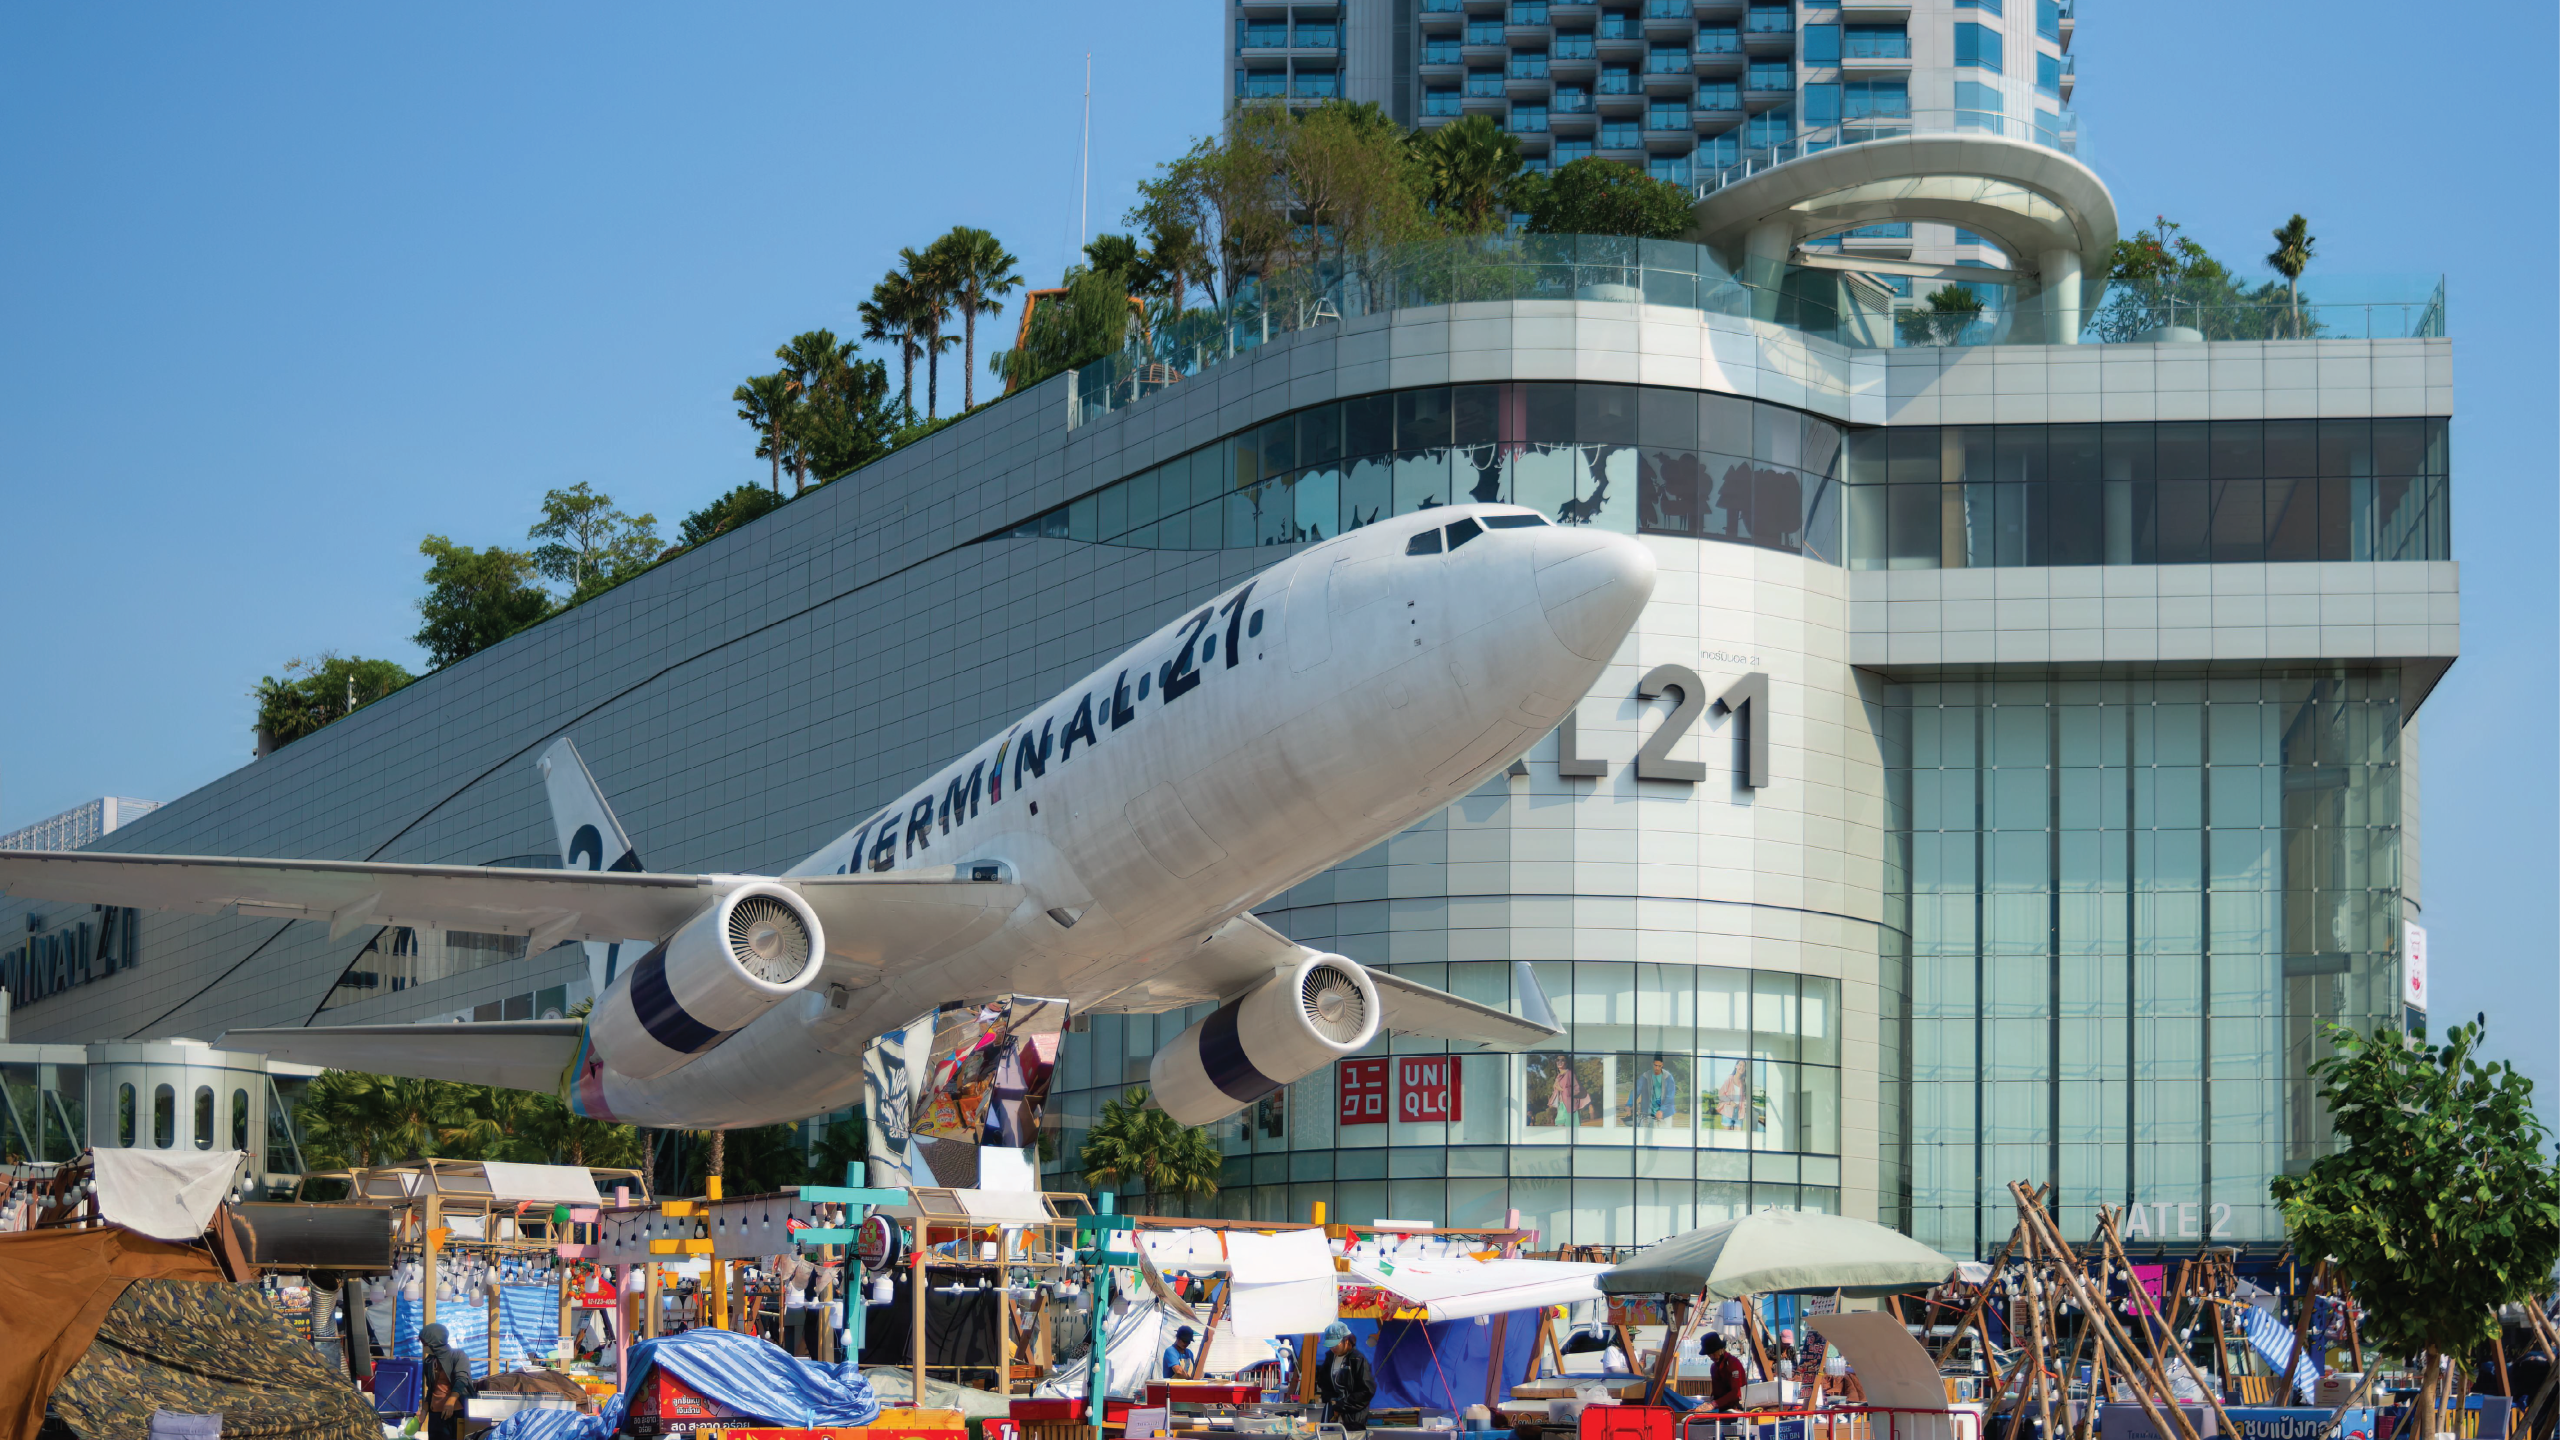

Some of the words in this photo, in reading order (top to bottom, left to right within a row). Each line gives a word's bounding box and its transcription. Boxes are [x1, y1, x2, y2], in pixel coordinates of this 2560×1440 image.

[1161, 578, 1259, 705] 21
[1750, 656, 1761, 666] 21
[1638, 664, 1769, 788] 21
[1405, 1063, 1447, 1086] UNI
[1405, 1091, 1452, 1117] QLO
[865, 1220, 877, 1243] 3
[2209, 1202, 2232, 1238] 2
